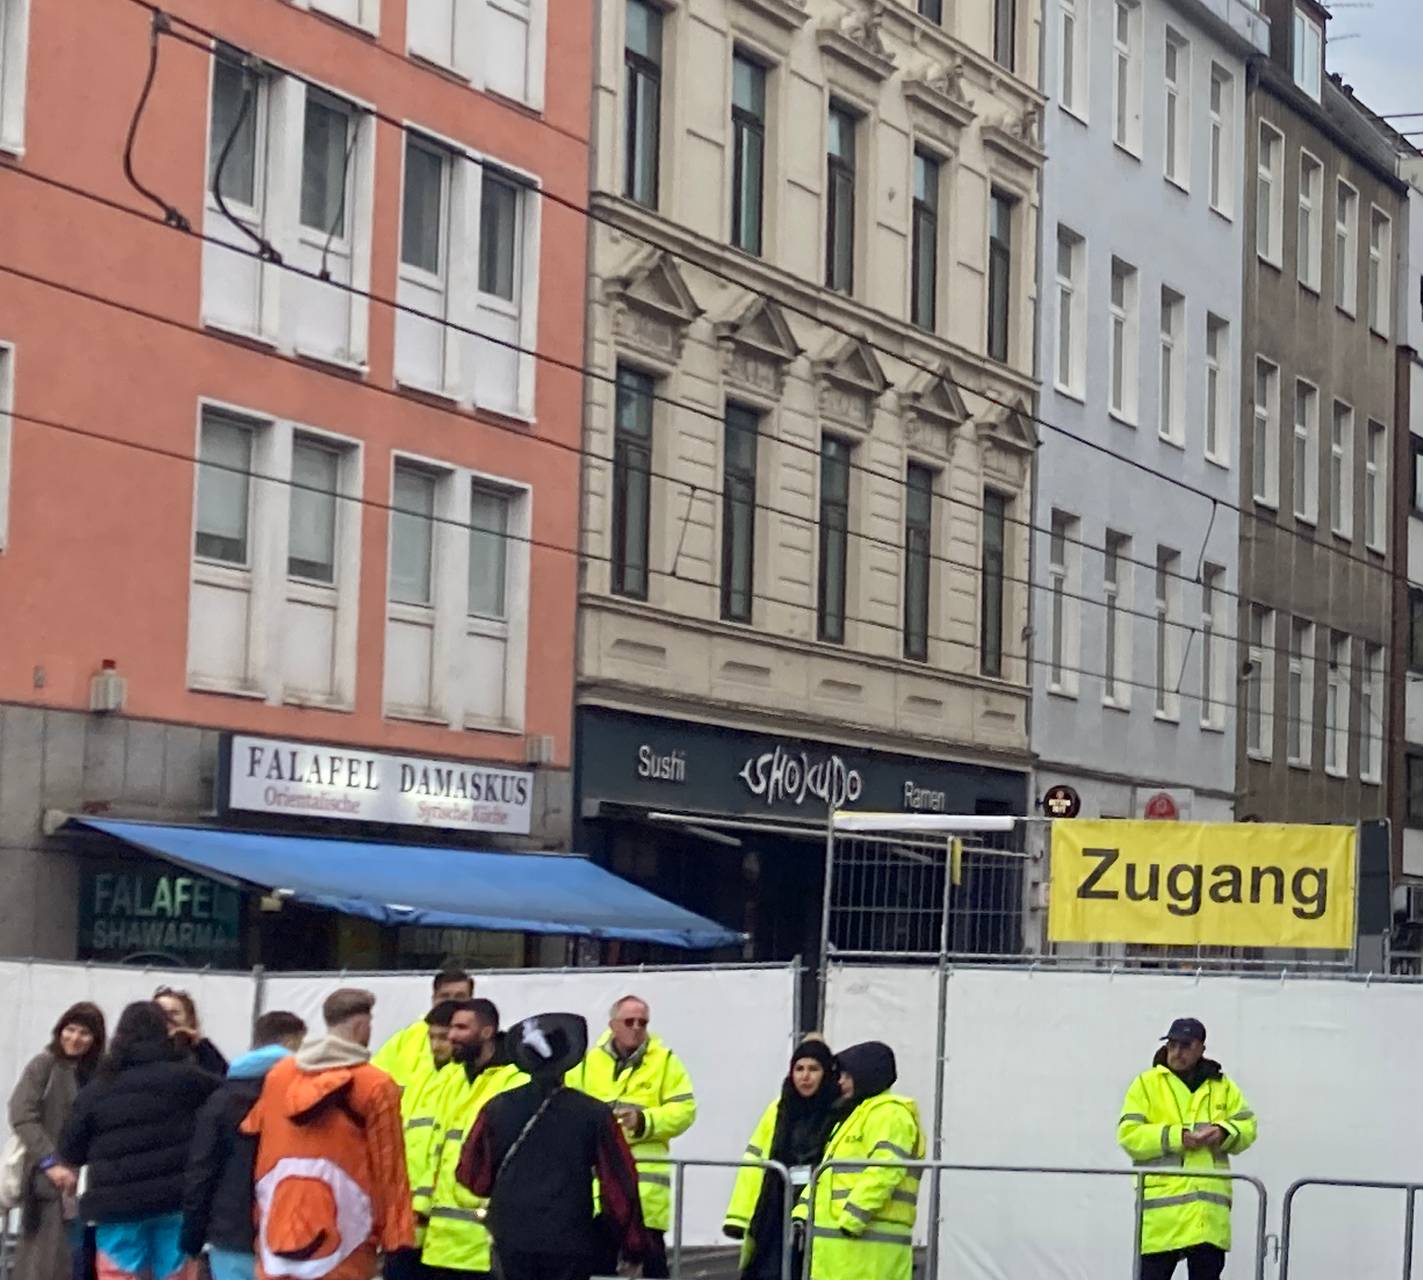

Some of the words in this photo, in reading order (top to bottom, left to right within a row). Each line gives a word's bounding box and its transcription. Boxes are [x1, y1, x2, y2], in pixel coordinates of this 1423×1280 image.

[247, 746, 379, 791] FALAFEL
[400, 763, 529, 808] DAMASKUS
[638, 744, 686, 782] Sushi
[904, 780, 946, 812] Ramen
[1076, 847, 1330, 921] Zugang
